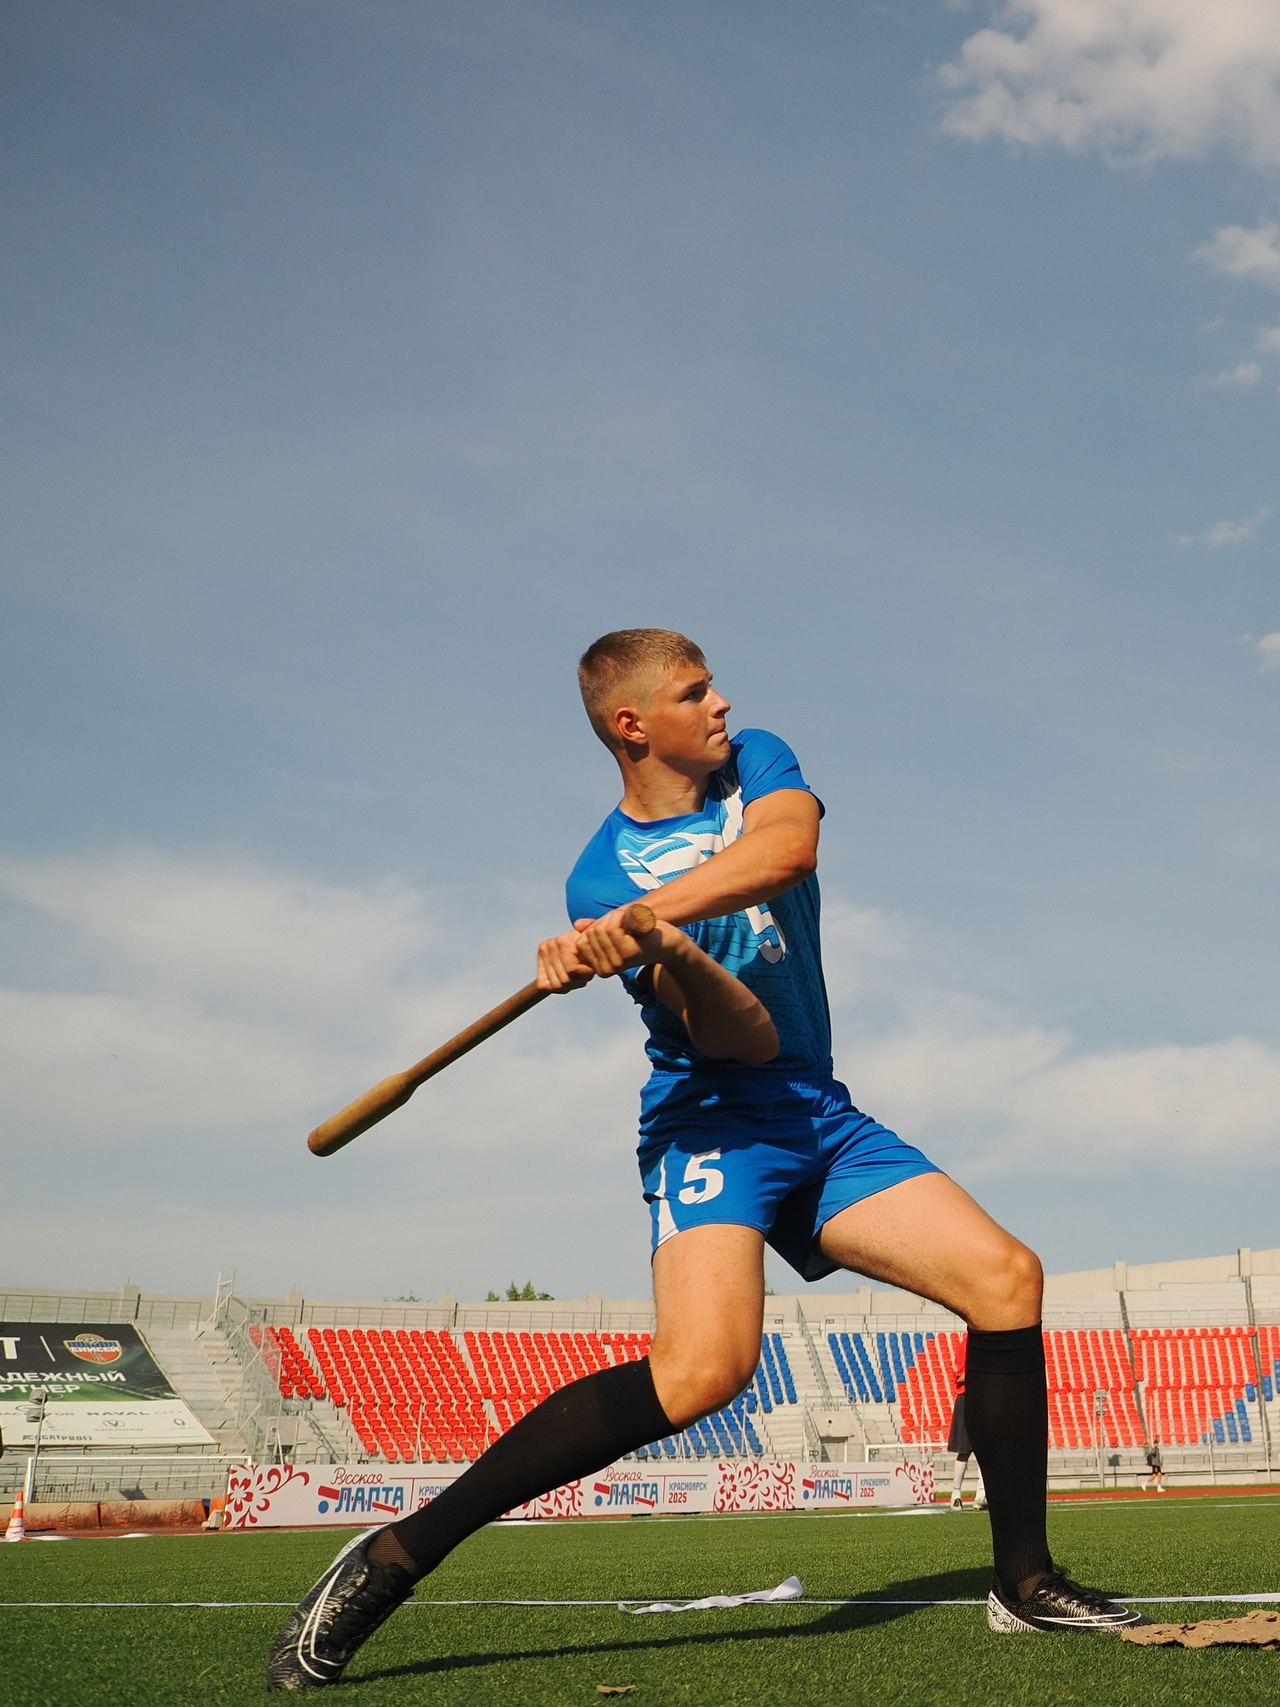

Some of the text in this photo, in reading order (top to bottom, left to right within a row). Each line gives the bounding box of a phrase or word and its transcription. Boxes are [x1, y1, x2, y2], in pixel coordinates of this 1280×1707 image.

[678, 1147, 724, 1205] 5
[70, 1345, 120, 1353] ЕНИСЕЙ
[330, 1467, 385, 1485] Русская
[603, 1466, 643, 1482] Русская
[809, 1464, 840, 1479] Русская
[669, 1482, 707, 1491] КРАСНОЯРСК
[812, 1479, 853, 1499] ЛАПТА
[860, 1478, 890, 1486] КРАСНОЯРСК
[335, 1486, 404, 1512] ЛАПТА
[607, 1483, 659, 1506] ЛАПТА
[668, 1492, 687, 1503] 2025
[860, 1487, 875, 1498] 2025
